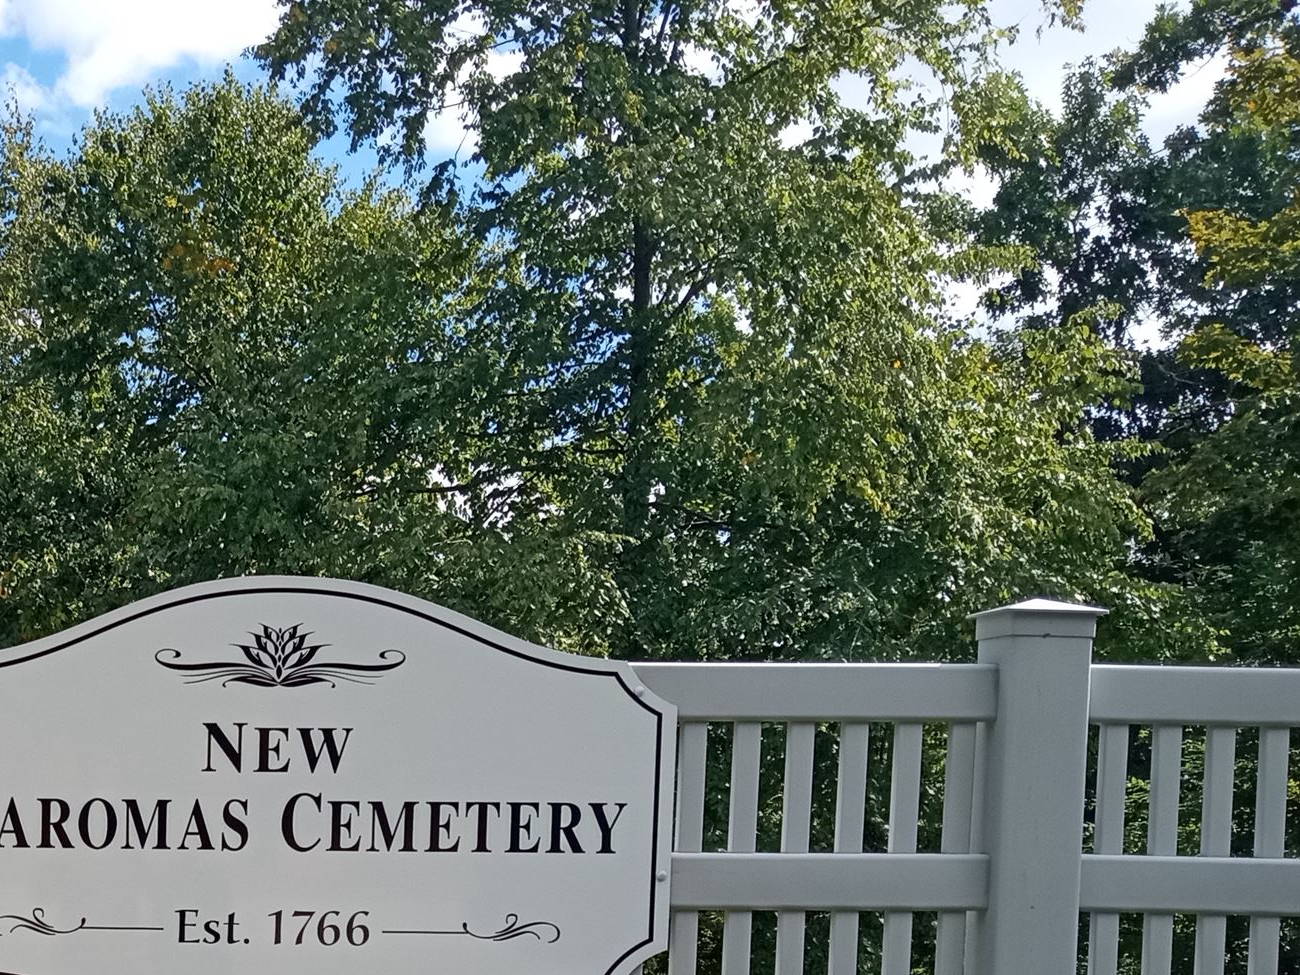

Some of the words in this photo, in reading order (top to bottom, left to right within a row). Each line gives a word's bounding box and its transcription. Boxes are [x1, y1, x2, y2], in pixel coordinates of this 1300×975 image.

[201, 722, 354, 774] NEW
[281, 792, 628, 855] CEMETERY
[174, 909, 250, 945] Est.
[268, 909, 370, 947] 1766
